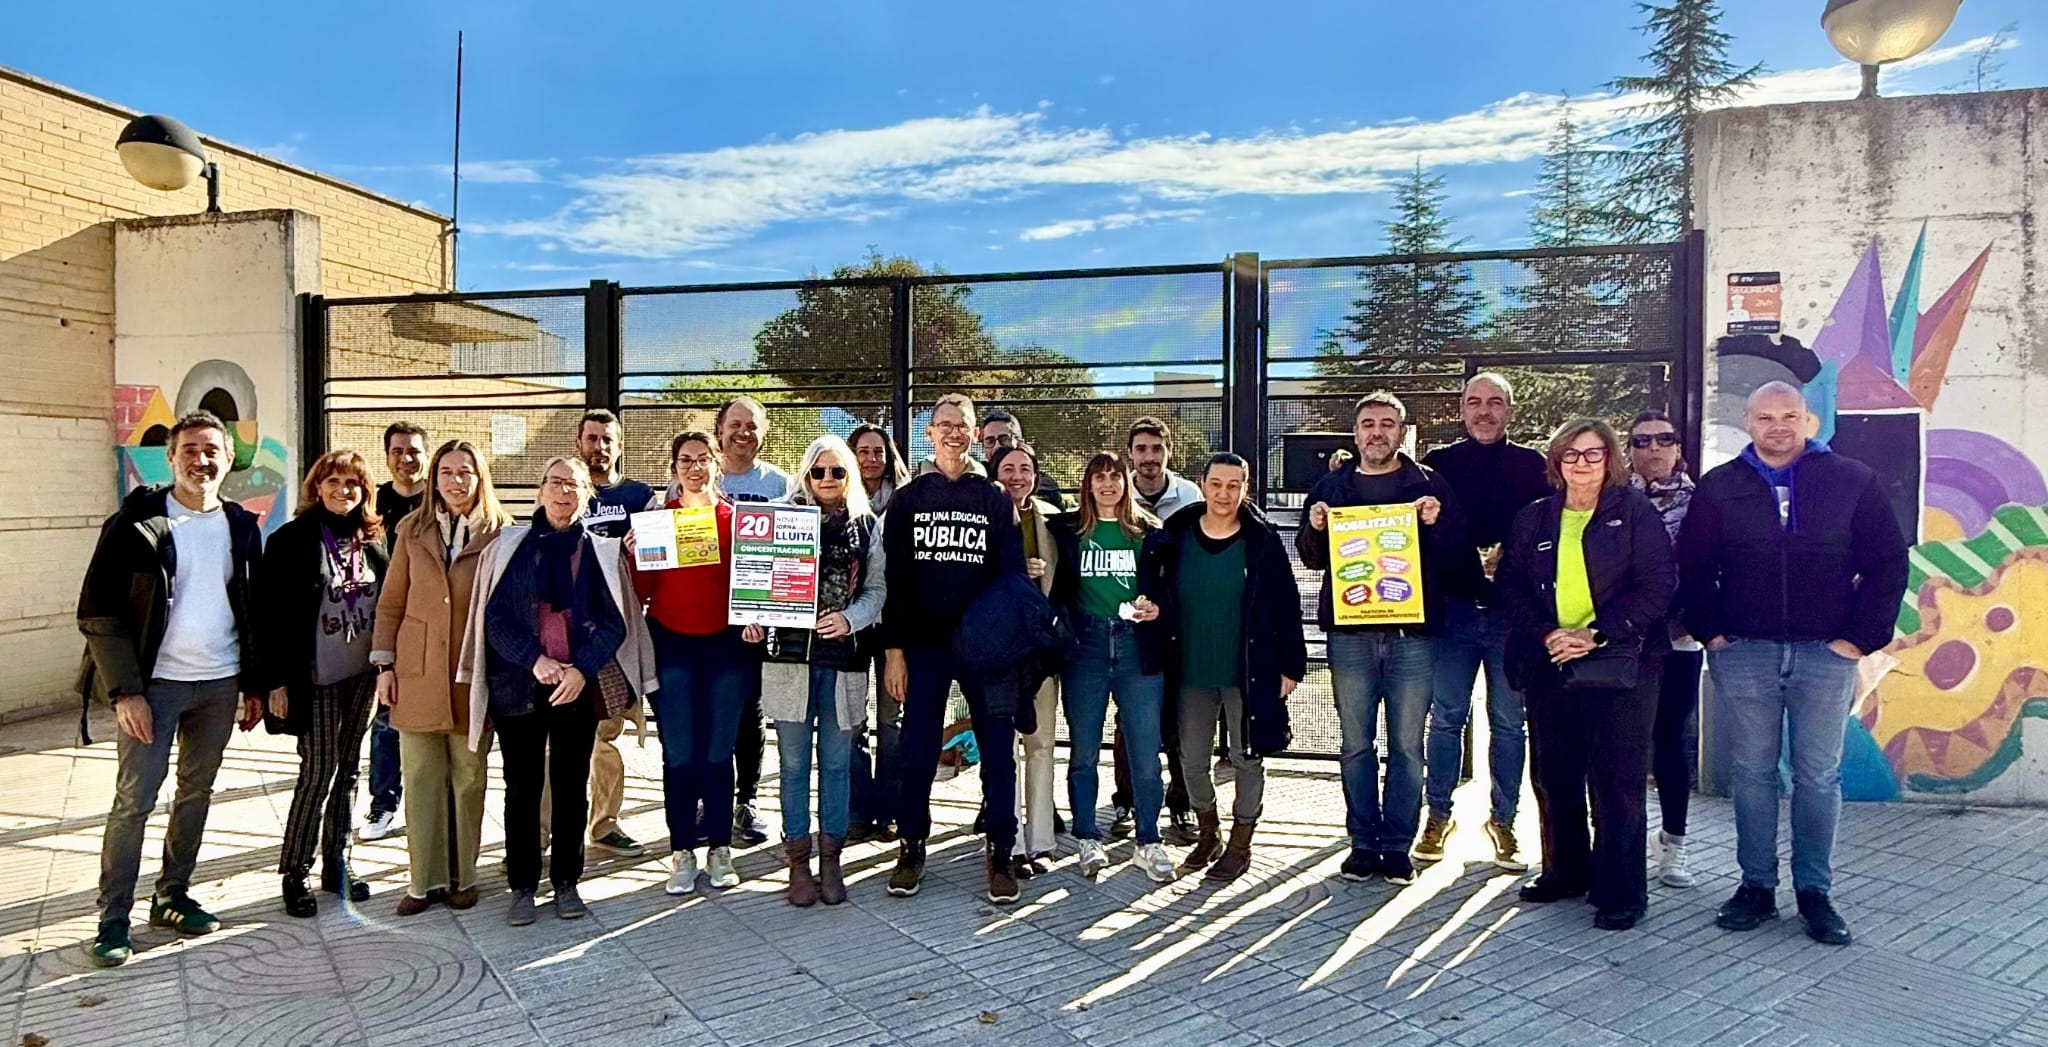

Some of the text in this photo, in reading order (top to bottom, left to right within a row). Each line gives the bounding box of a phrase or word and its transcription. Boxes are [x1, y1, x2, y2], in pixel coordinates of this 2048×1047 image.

[593, 501, 626, 516] Jeans
[914, 512, 932, 522] PER
[932, 511, 950, 521] UNA
[739, 515, 769, 537] 20
[776, 532, 814, 542] LLUITA
[913, 521, 987, 551] PÚBLICA
[918, 551, 933, 560] DE
[934, 551, 985, 564] QUALITAT
[1080, 549, 1137, 572] LA LLENGUA
